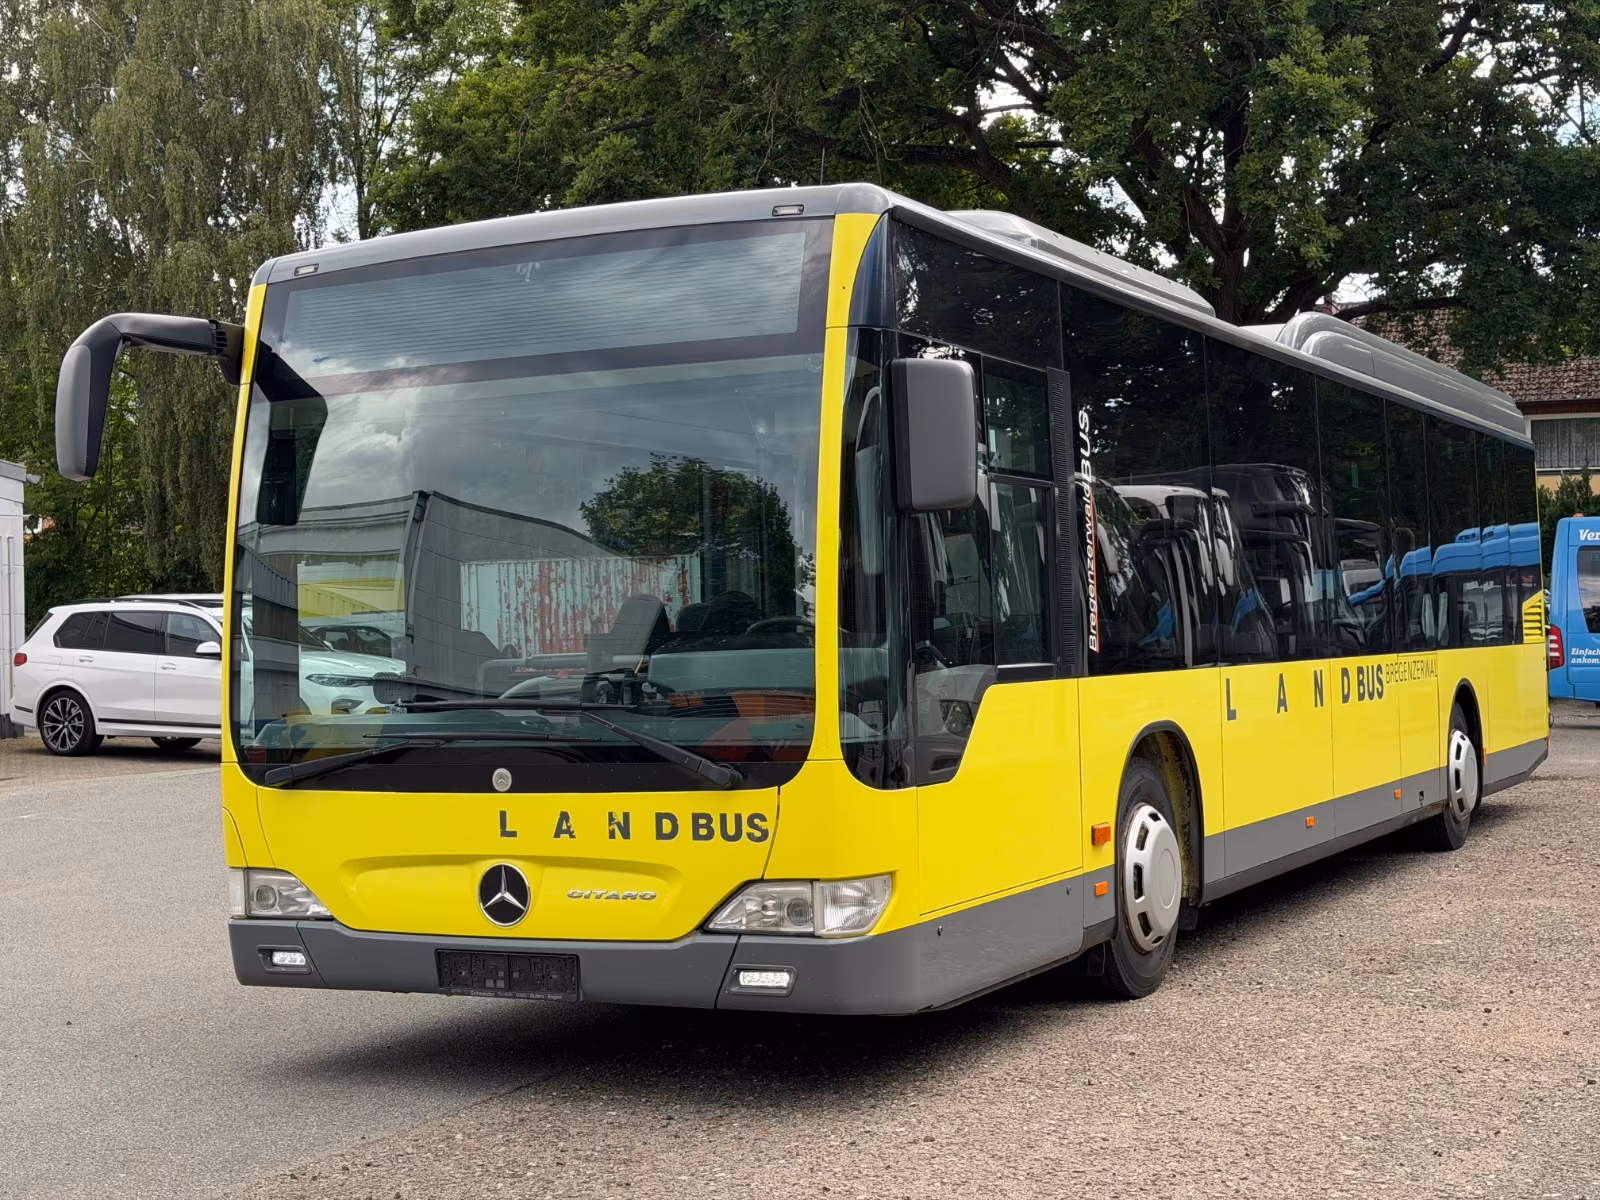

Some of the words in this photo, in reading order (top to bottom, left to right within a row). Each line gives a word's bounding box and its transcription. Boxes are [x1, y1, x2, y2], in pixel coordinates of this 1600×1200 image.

[1571, 656, 1600, 664] ankom
[1225, 663, 1384, 721] LANDBUS
[499, 810, 770, 843] LANDBUS
[566, 889, 657, 901] CITARO
